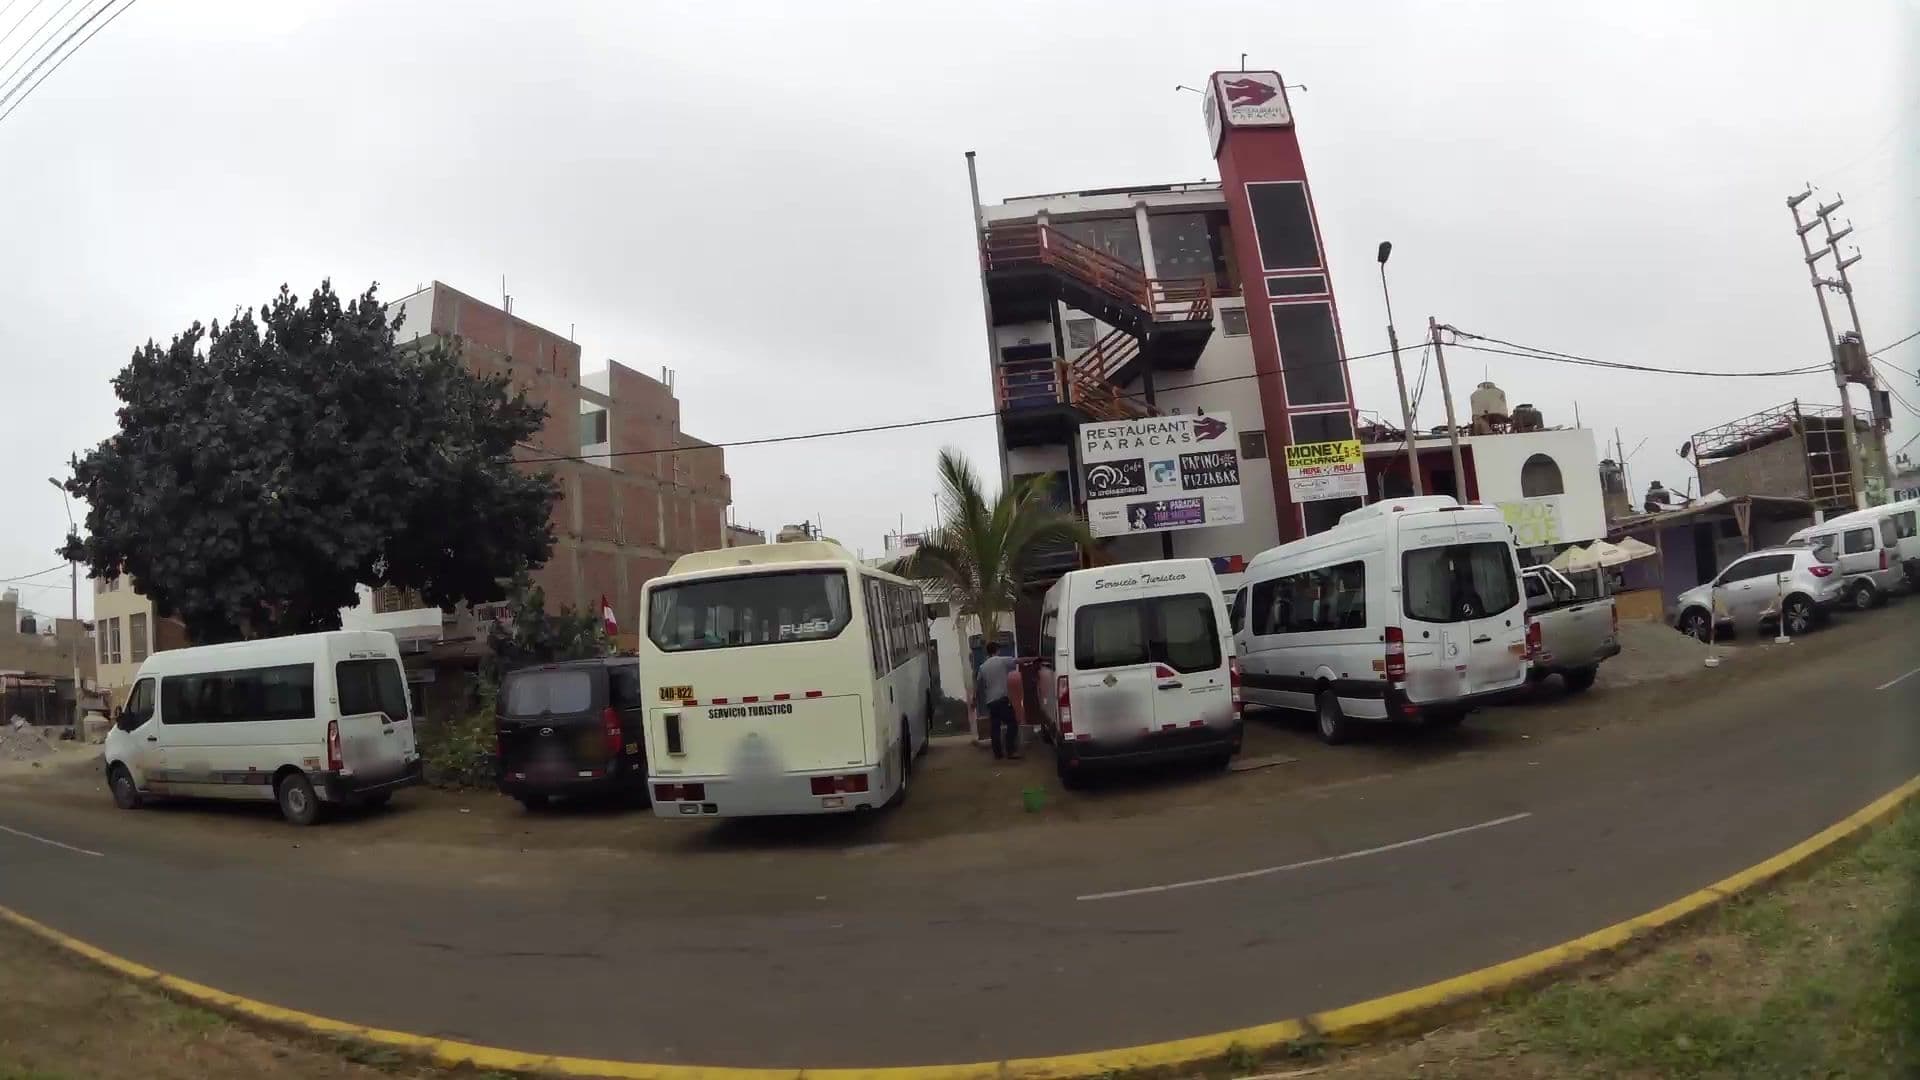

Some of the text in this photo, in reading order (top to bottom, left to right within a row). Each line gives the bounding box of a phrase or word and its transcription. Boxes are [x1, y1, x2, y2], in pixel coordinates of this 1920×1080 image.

[1087, 421, 1188, 440] RESTAURANT
[1088, 433, 1190, 452] PARACAS
[1287, 443, 1342, 459] MONEY
[1182, 454, 1219, 469] PAPINO
[1289, 455, 1344, 466] EXCHANGE
[1184, 470, 1238, 487] PIZZABAR
[1095, 578, 1137, 590] Servicio
[780, 621, 829, 637] FUSO
[708, 703, 792, 719] SERVICIO TURISTICO
